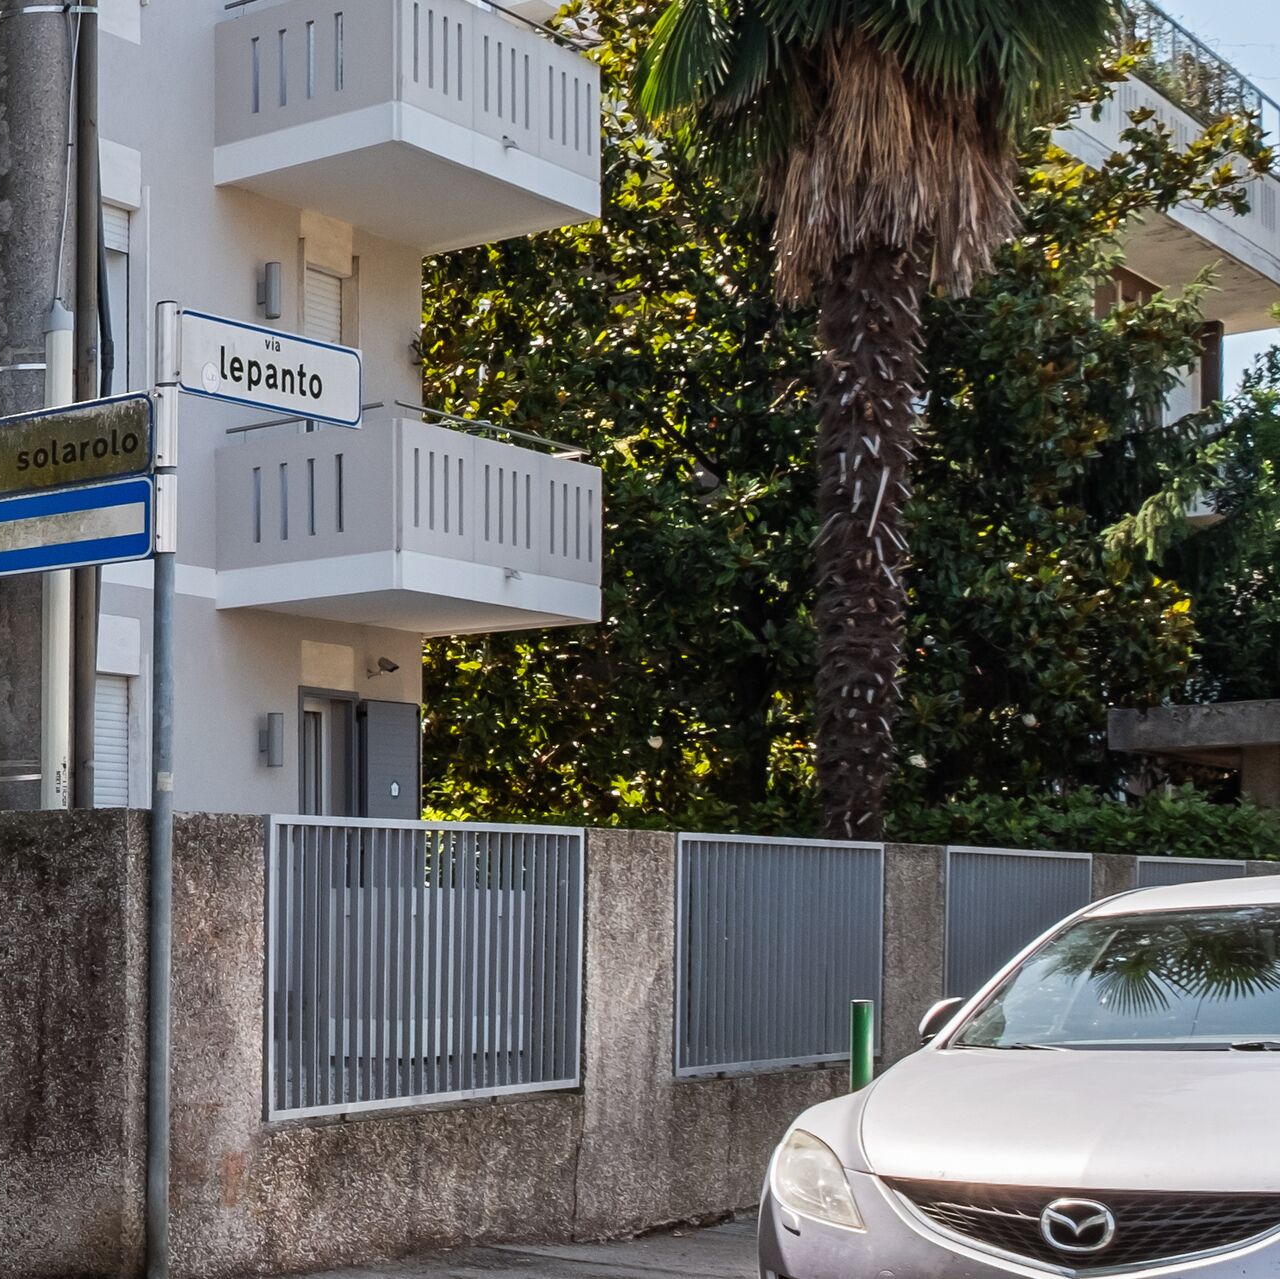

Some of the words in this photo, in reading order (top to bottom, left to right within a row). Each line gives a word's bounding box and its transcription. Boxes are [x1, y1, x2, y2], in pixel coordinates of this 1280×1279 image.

[264, 336, 281, 352] via
[220, 345, 323, 400] lepanto
[17, 428, 139, 472] solarolo
